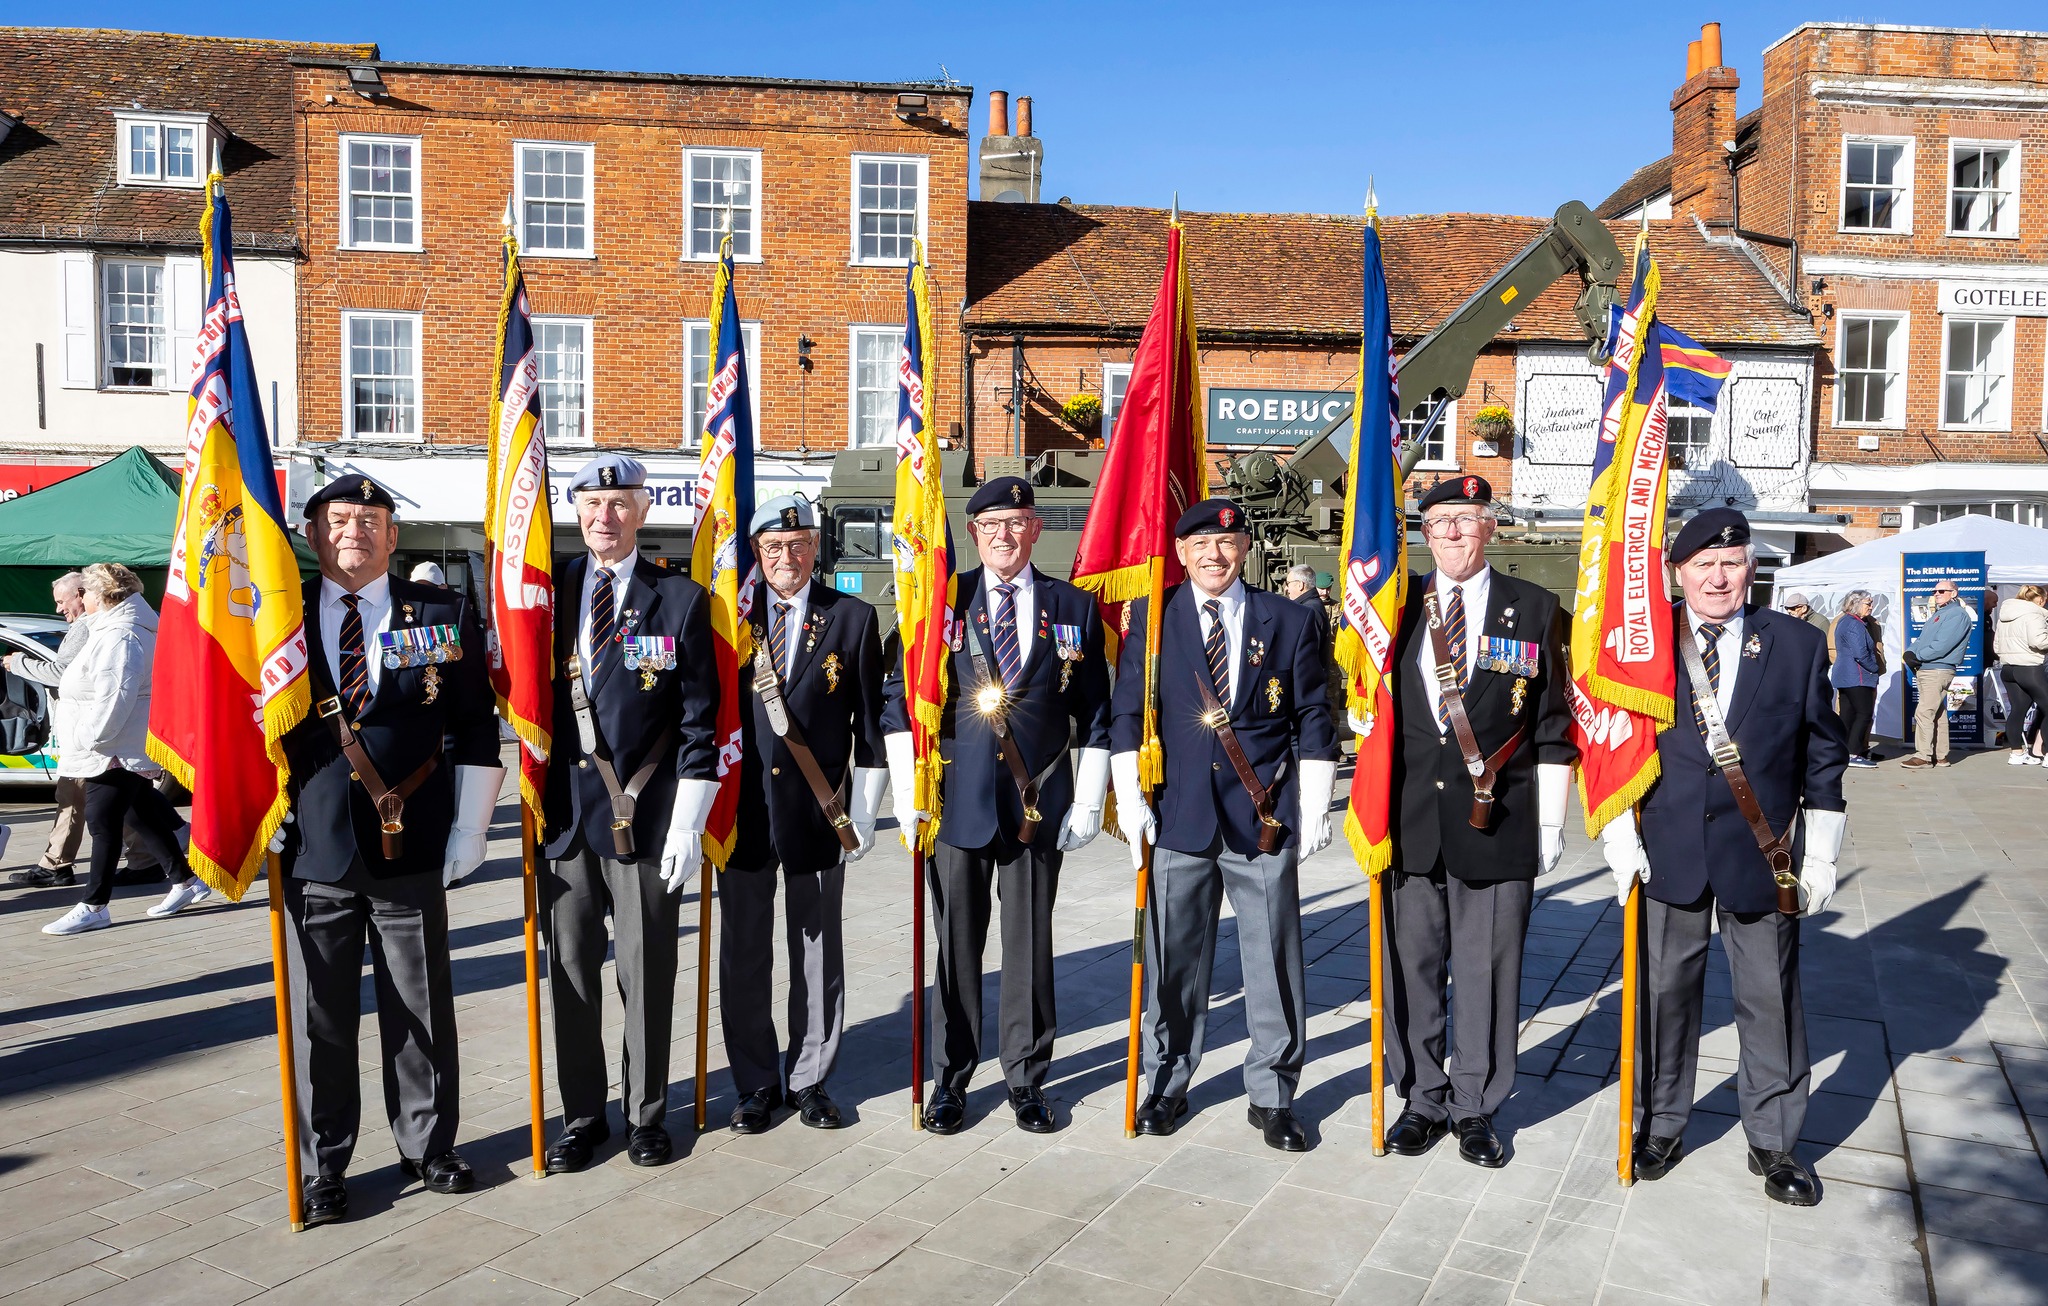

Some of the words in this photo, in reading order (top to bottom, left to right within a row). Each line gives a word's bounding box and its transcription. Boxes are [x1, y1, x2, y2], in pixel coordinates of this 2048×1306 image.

[1954, 288, 2047, 307] GOTELEE
[1218, 398, 1351, 422] ROEBUC
[1542, 407, 1586, 419] Indian
[1528, 418, 1599, 437] Restaurant
[1744, 423, 1786, 439] Lounge
[1631, 478, 1652, 507] AND
[1628, 513, 1647, 600] ELECTRICAL
[842, 576, 855, 588] T1
[1345, 587, 1386, 662] ADQUARTER
[1629, 606, 1649, 655] ROYAL
[1564, 681, 1594, 730] BRANCH
